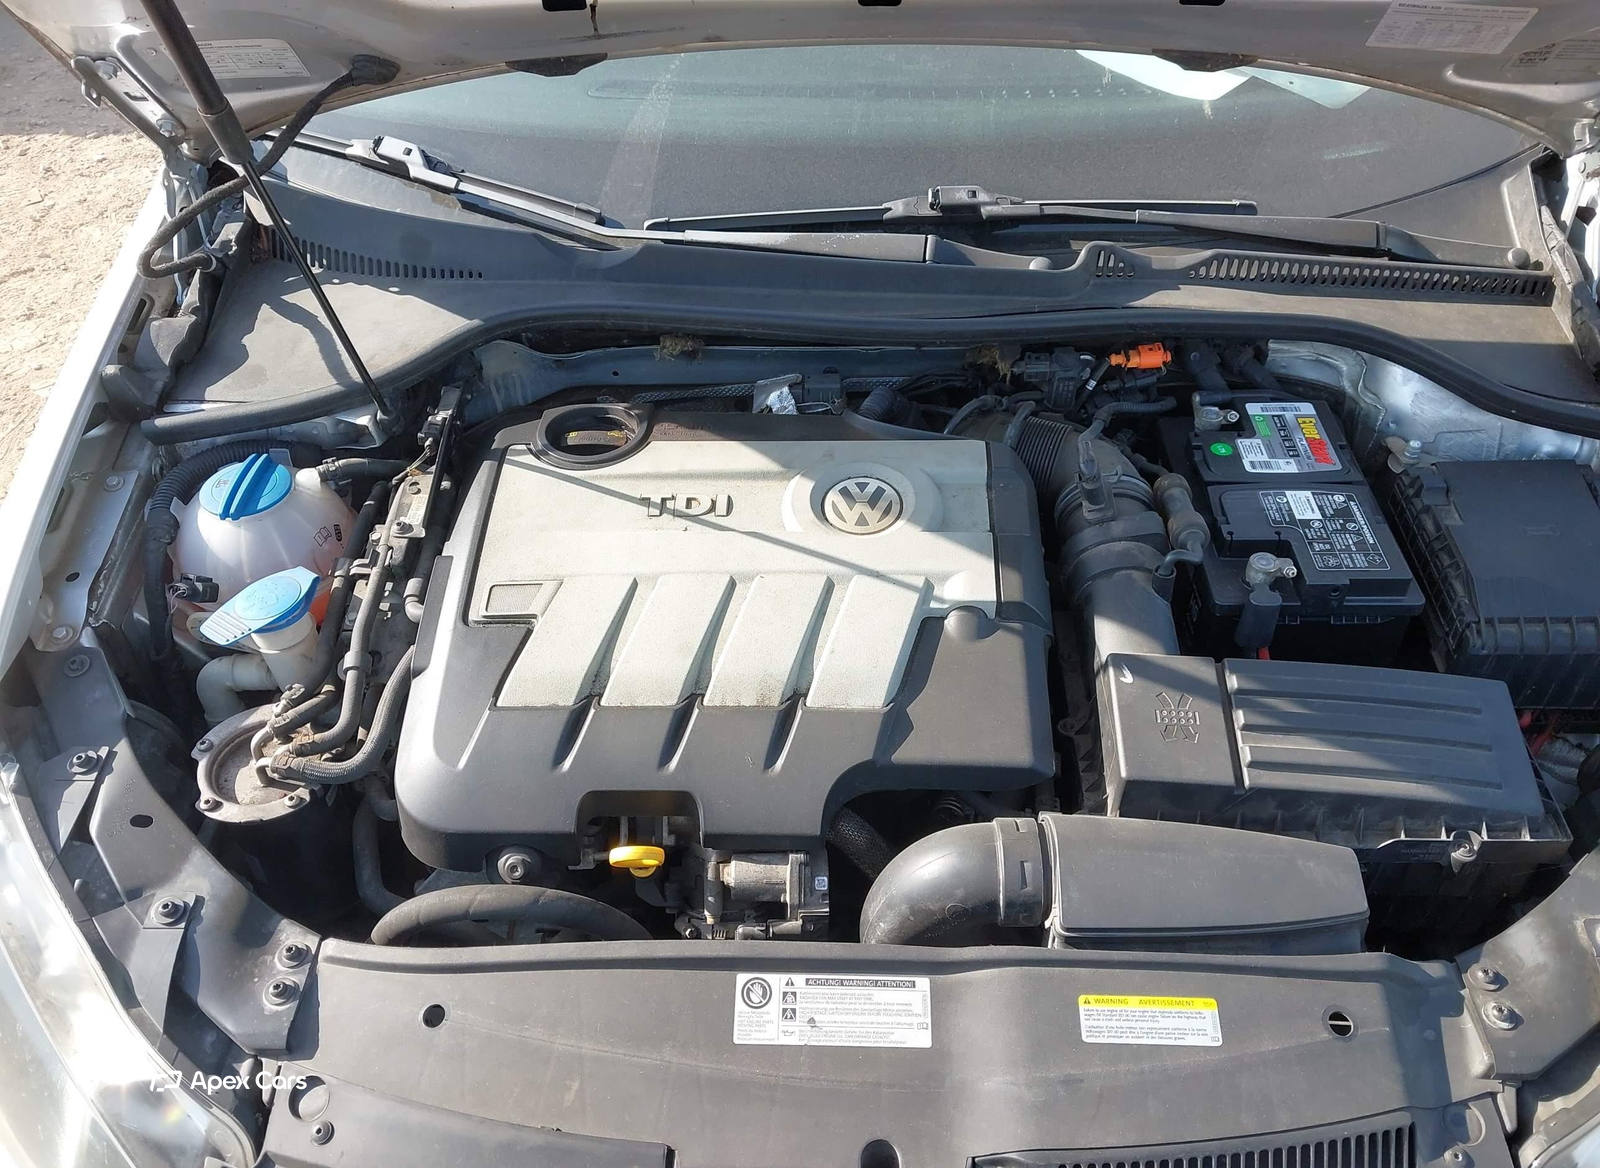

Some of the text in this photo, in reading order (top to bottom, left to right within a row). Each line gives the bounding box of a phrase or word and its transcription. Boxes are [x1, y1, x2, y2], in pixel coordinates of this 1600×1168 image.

[1296, 416, 1335, 464] EverStart
[639, 493, 734, 517] TDI
[1351, 505, 1374, 543] DANGER POISON
